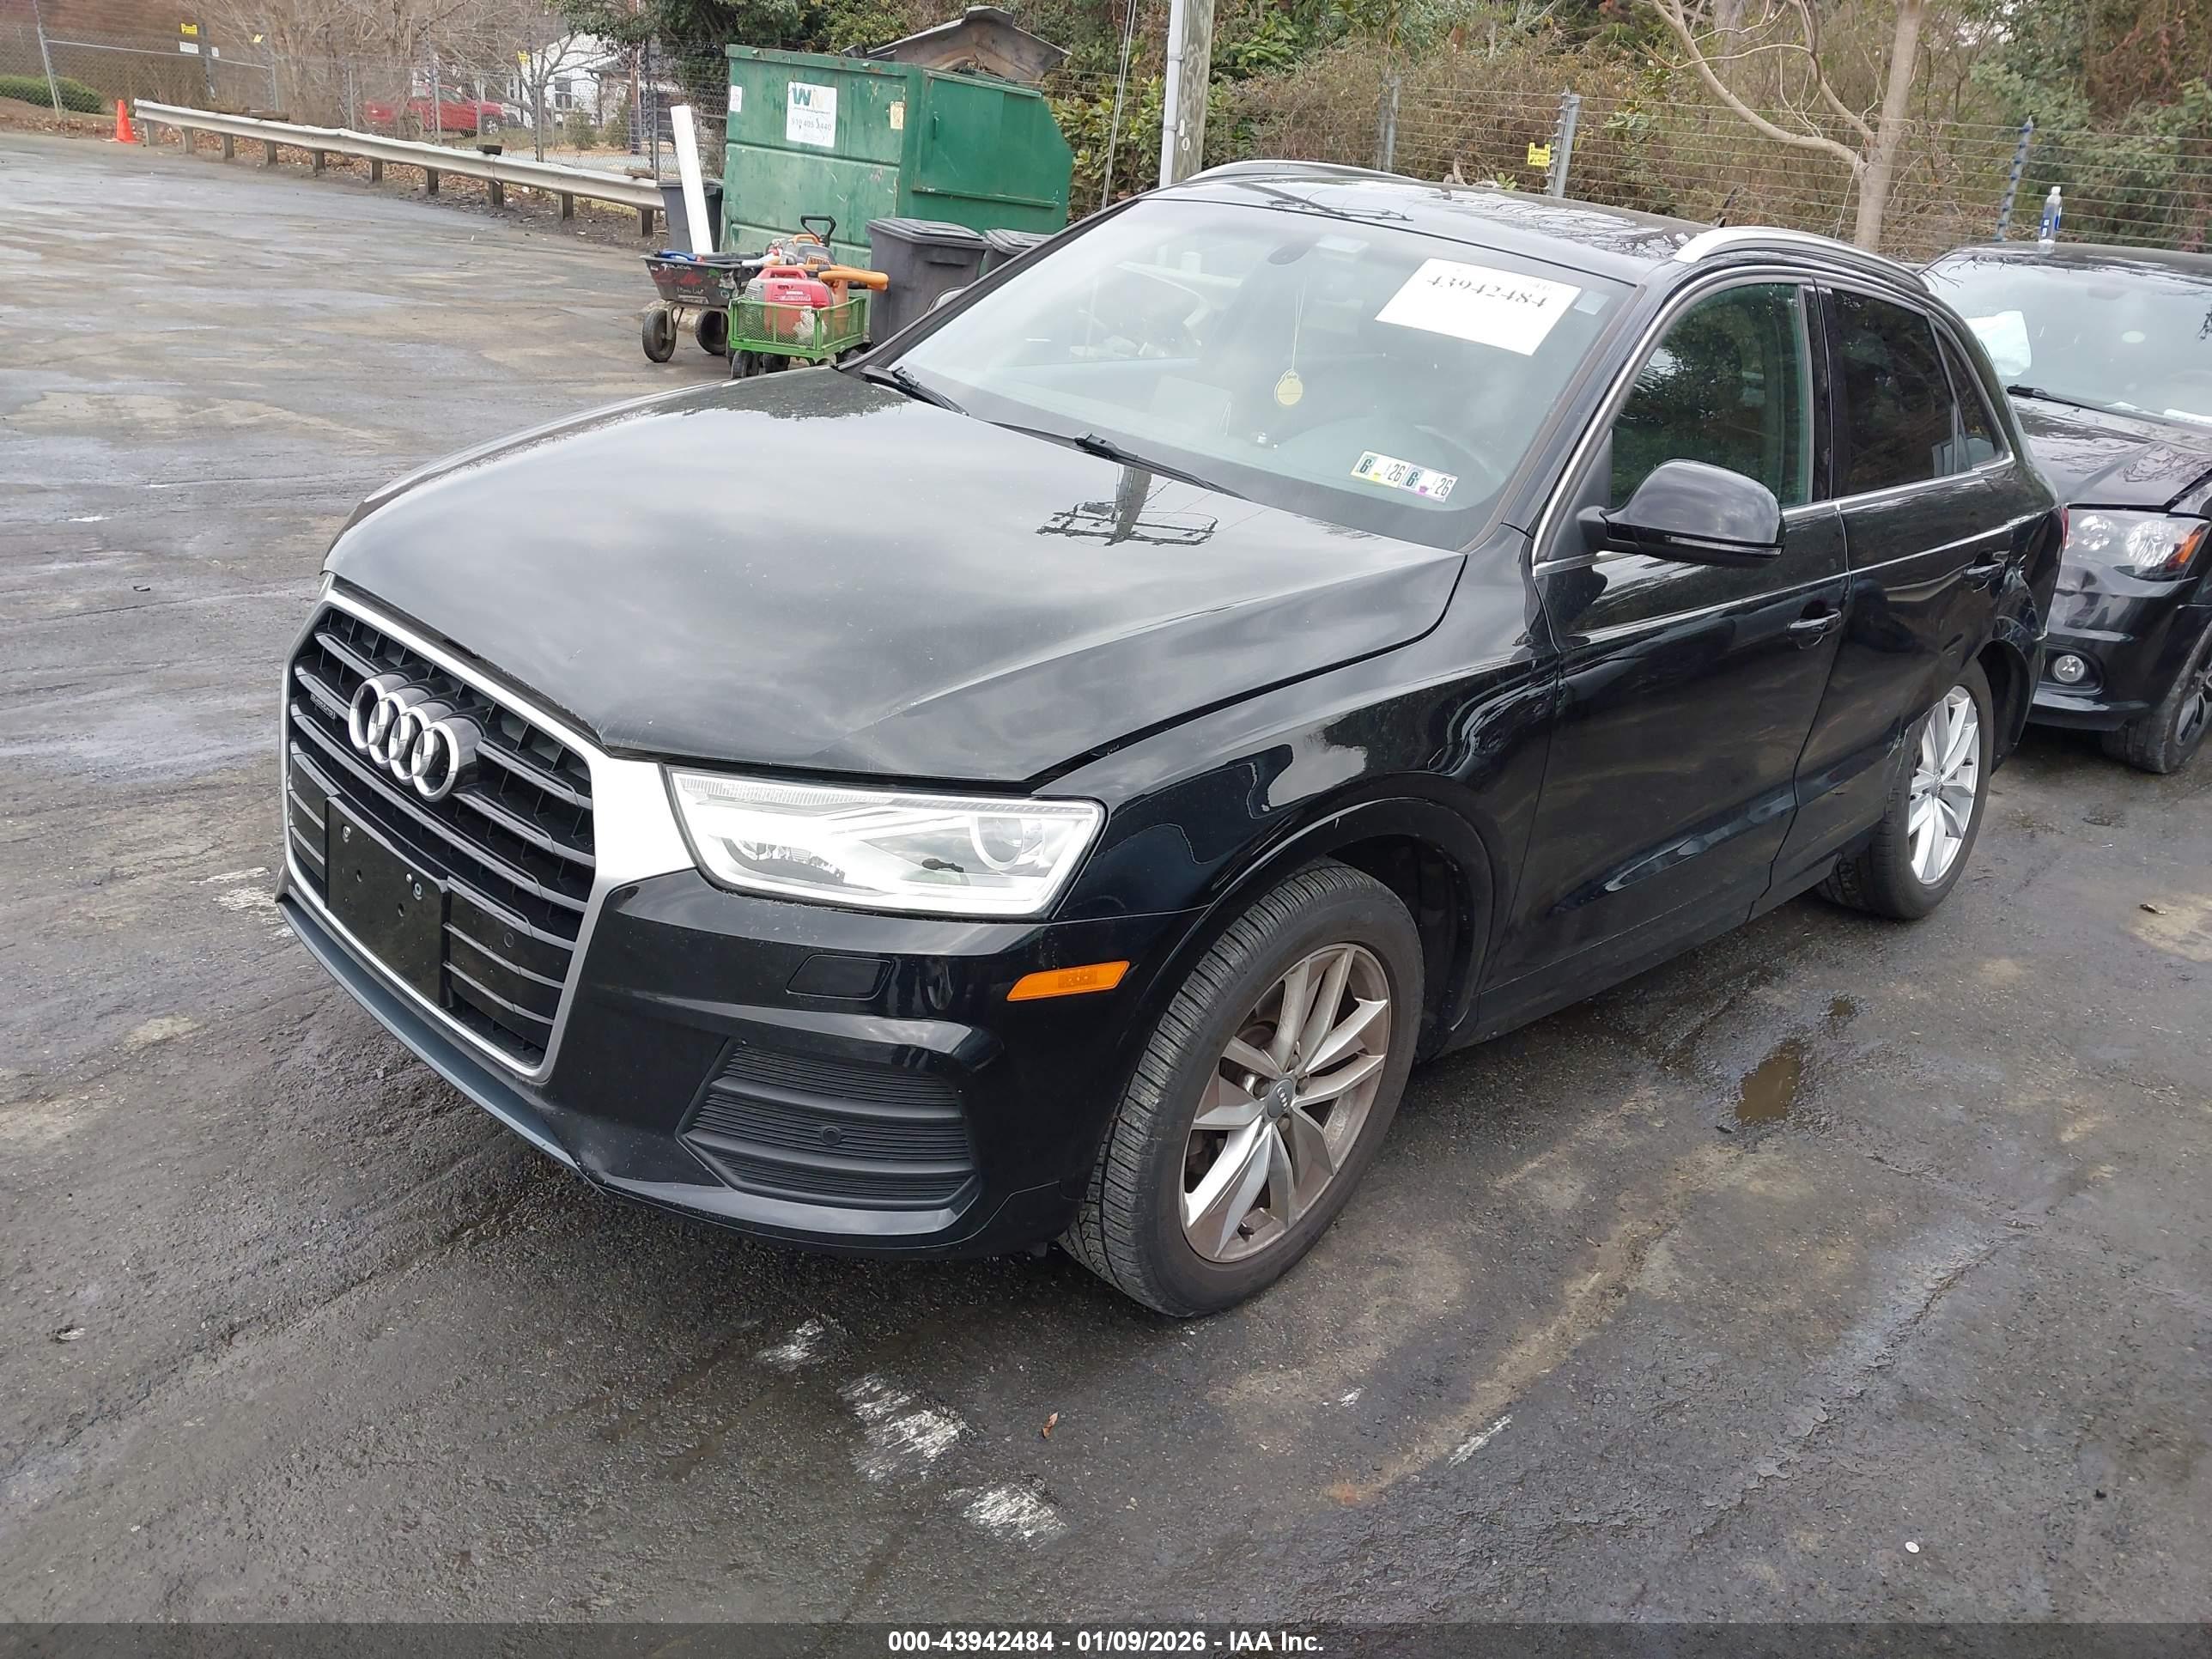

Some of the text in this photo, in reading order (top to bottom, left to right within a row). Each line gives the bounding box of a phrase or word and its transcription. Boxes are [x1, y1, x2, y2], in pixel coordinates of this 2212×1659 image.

[1427, 275, 1547, 308] 43942484
[1359, 459, 1454, 496] 6 26 6 26
